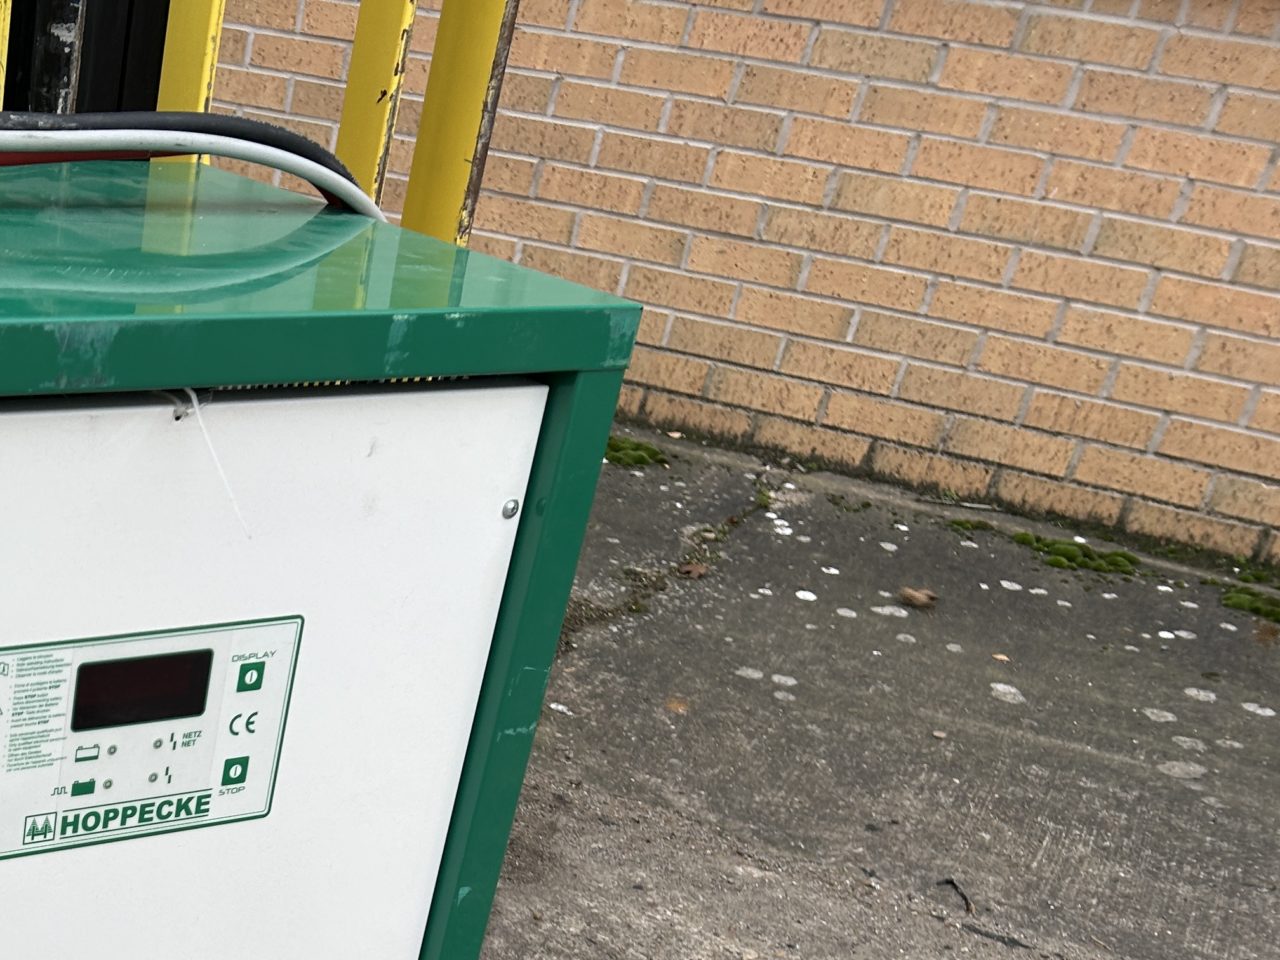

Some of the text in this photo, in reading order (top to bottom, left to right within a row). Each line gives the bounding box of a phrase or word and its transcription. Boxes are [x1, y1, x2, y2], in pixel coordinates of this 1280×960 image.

[231, 650, 278, 663] DISPLAY
[182, 730, 203, 739] NETZ
[181, 739, 197, 748] NET
[218, 785, 246, 797] STOP
[59, 793, 213, 837] HOPPECKE
